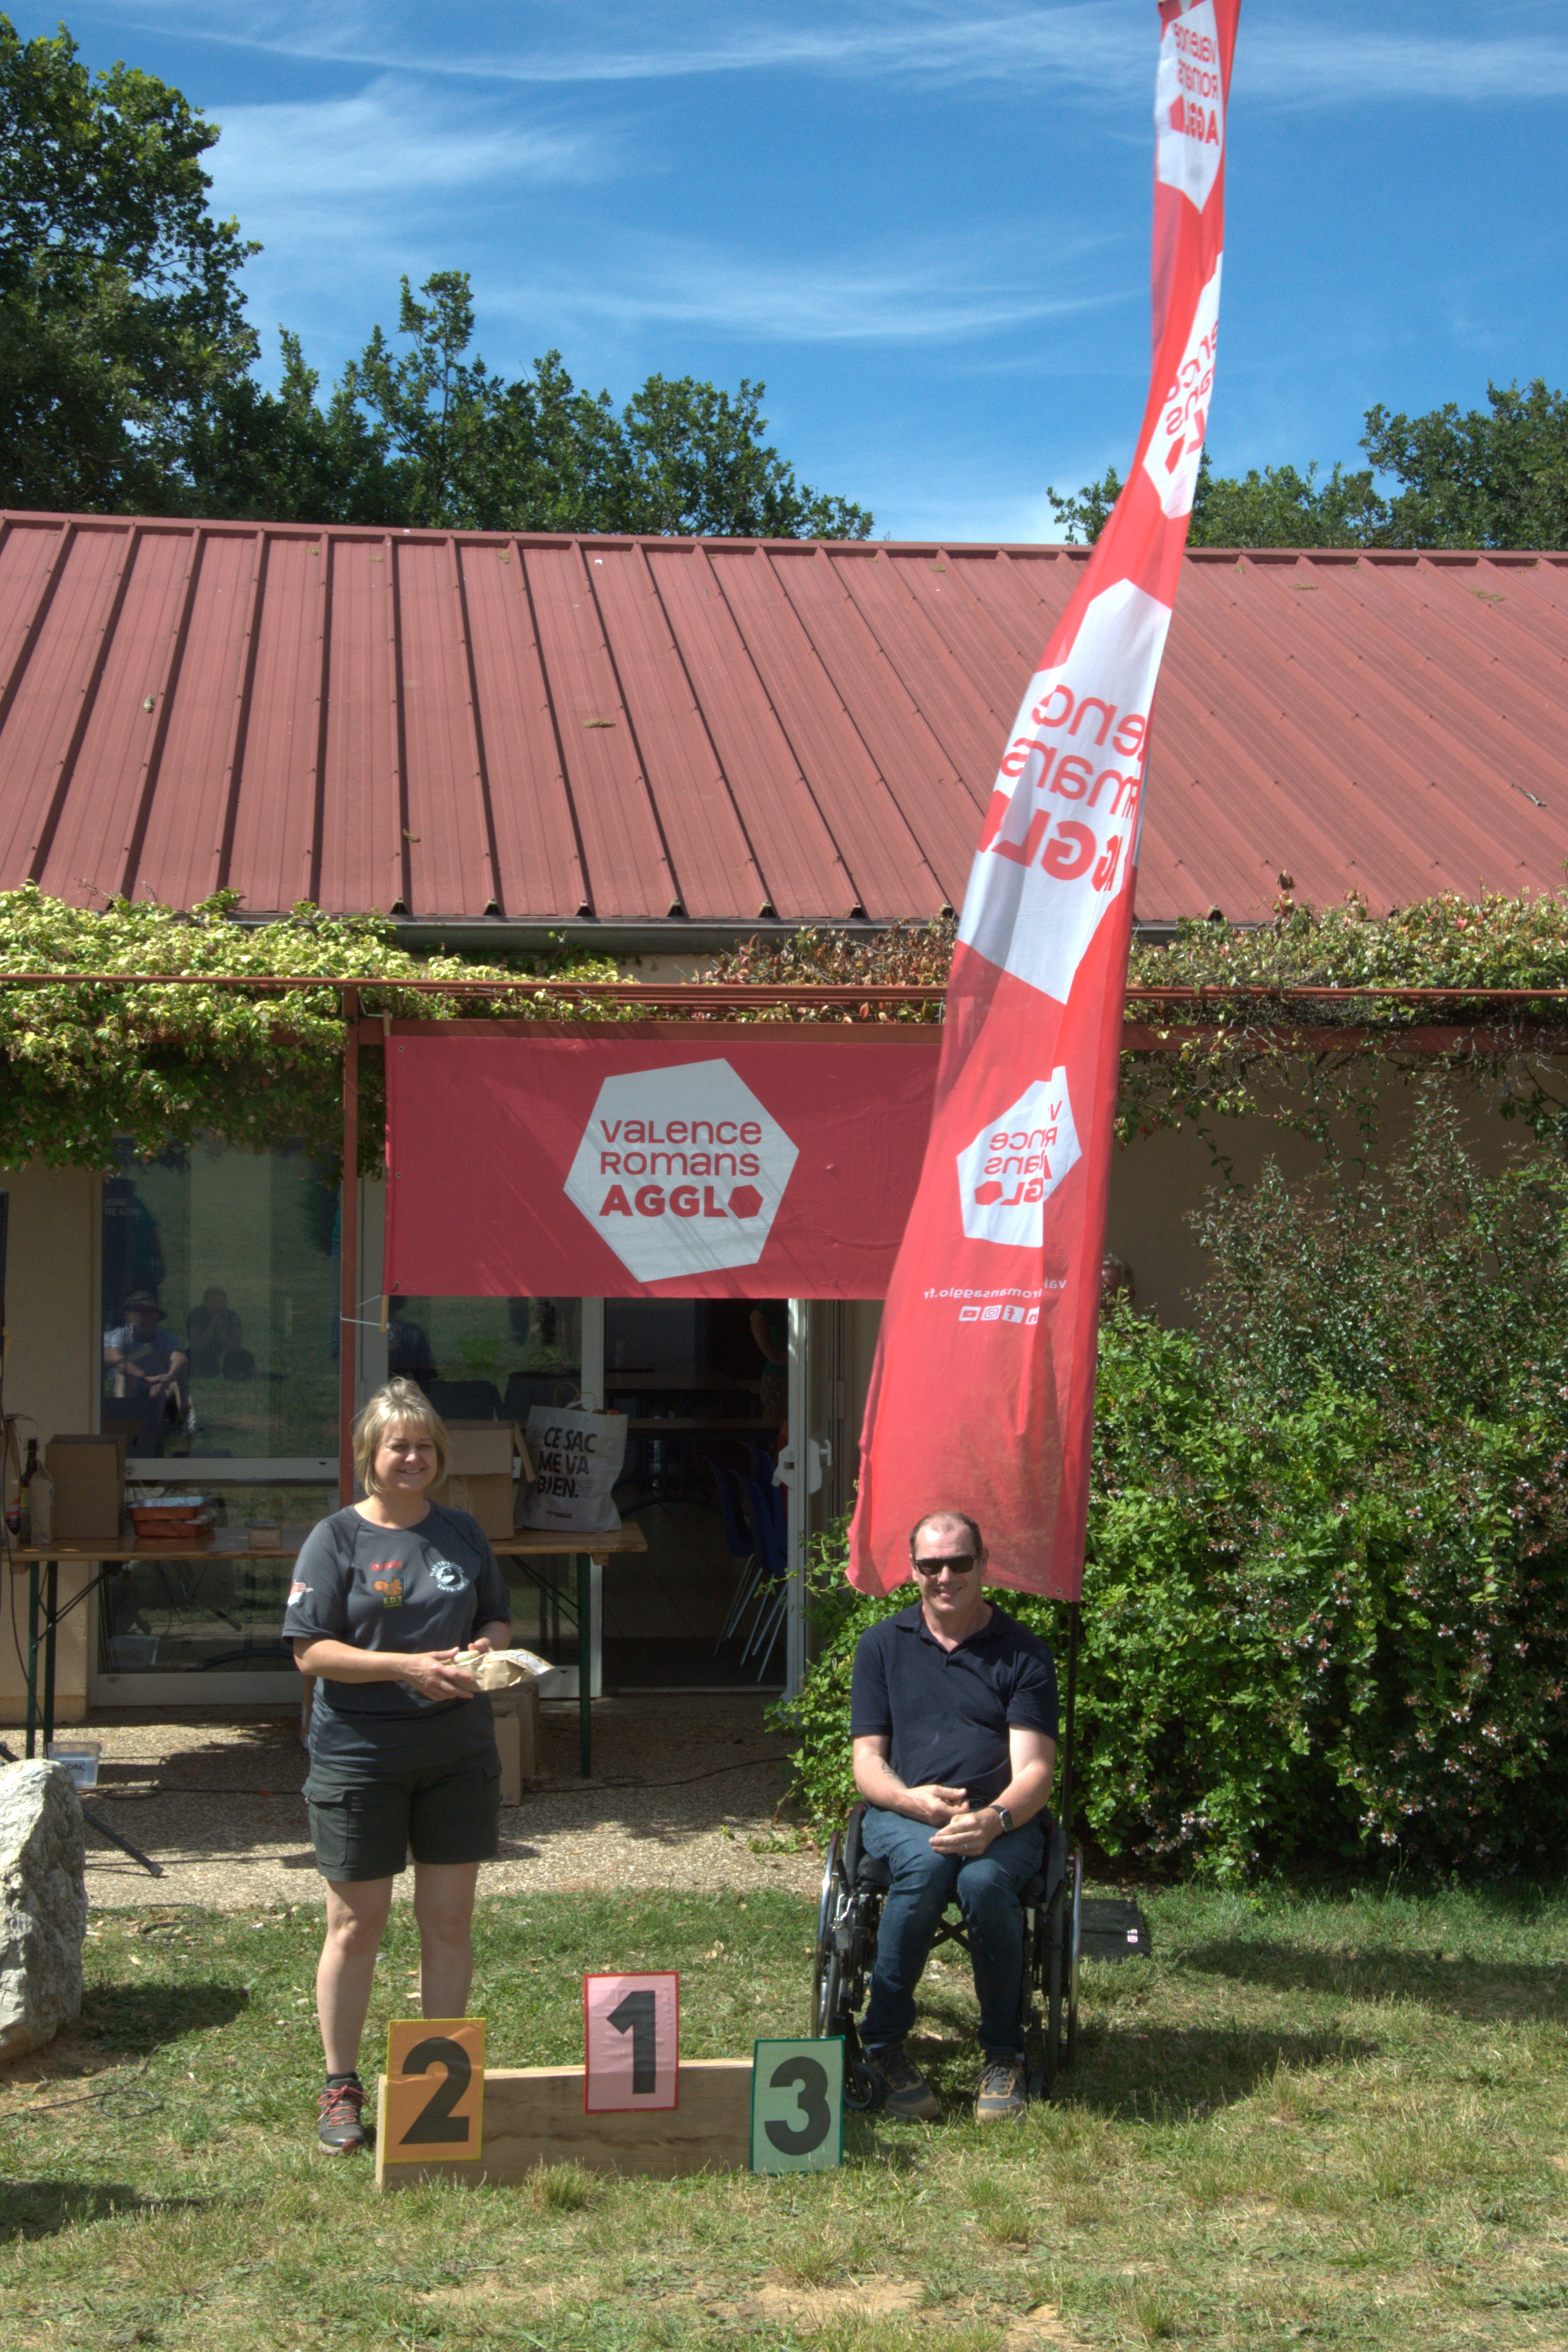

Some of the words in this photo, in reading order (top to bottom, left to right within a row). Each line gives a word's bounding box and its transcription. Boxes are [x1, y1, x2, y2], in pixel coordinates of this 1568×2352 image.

[599, 1184, 764, 1219] AGGLO
[544, 1427, 563, 1449] CE
[563, 1429, 597, 1453] SAC
[538, 1451, 563, 1473] ME
[565, 1455, 590, 1475] VA
[536, 1475, 579, 1498] BIEN.
[606, 1990, 656, 2094] 1
[398, 2037, 471, 2145] 2
[764, 2056, 831, 2155] 3
